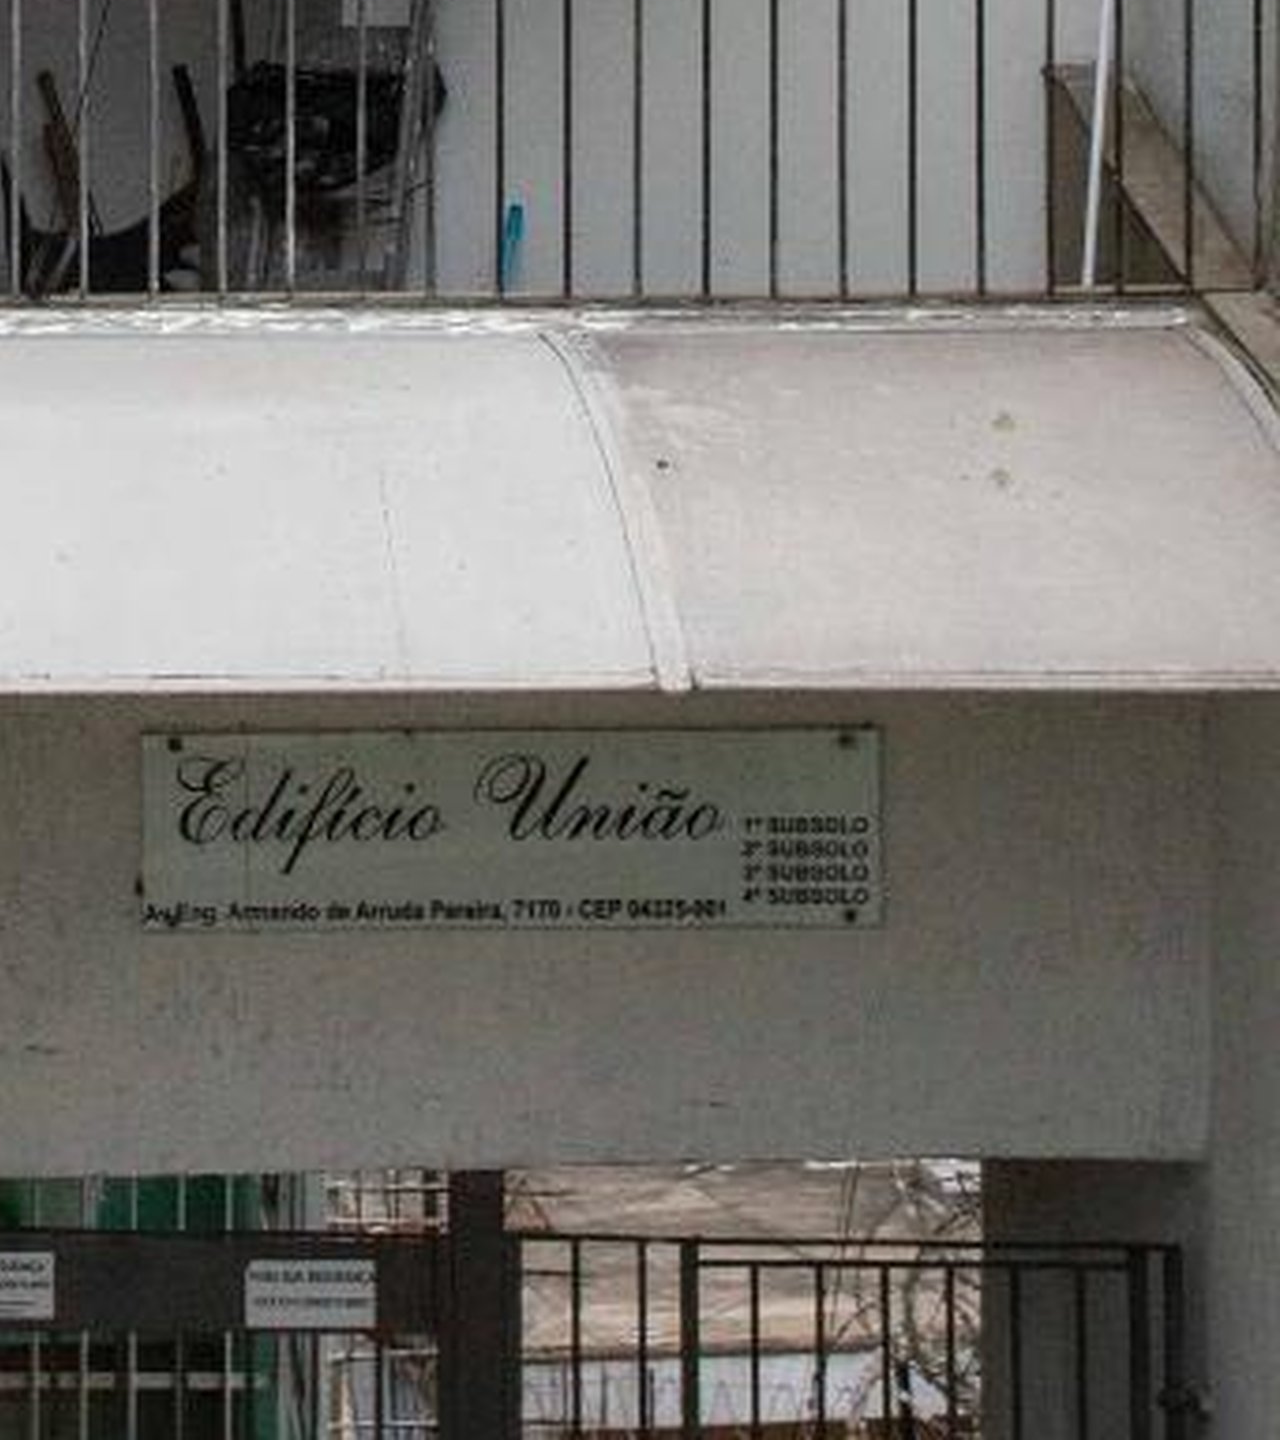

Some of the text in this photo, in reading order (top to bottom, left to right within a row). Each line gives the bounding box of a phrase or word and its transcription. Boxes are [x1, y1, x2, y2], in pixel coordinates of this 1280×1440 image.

[176, 753, 726, 876] Edifício União
[578, 899, 622, 920] CEP
